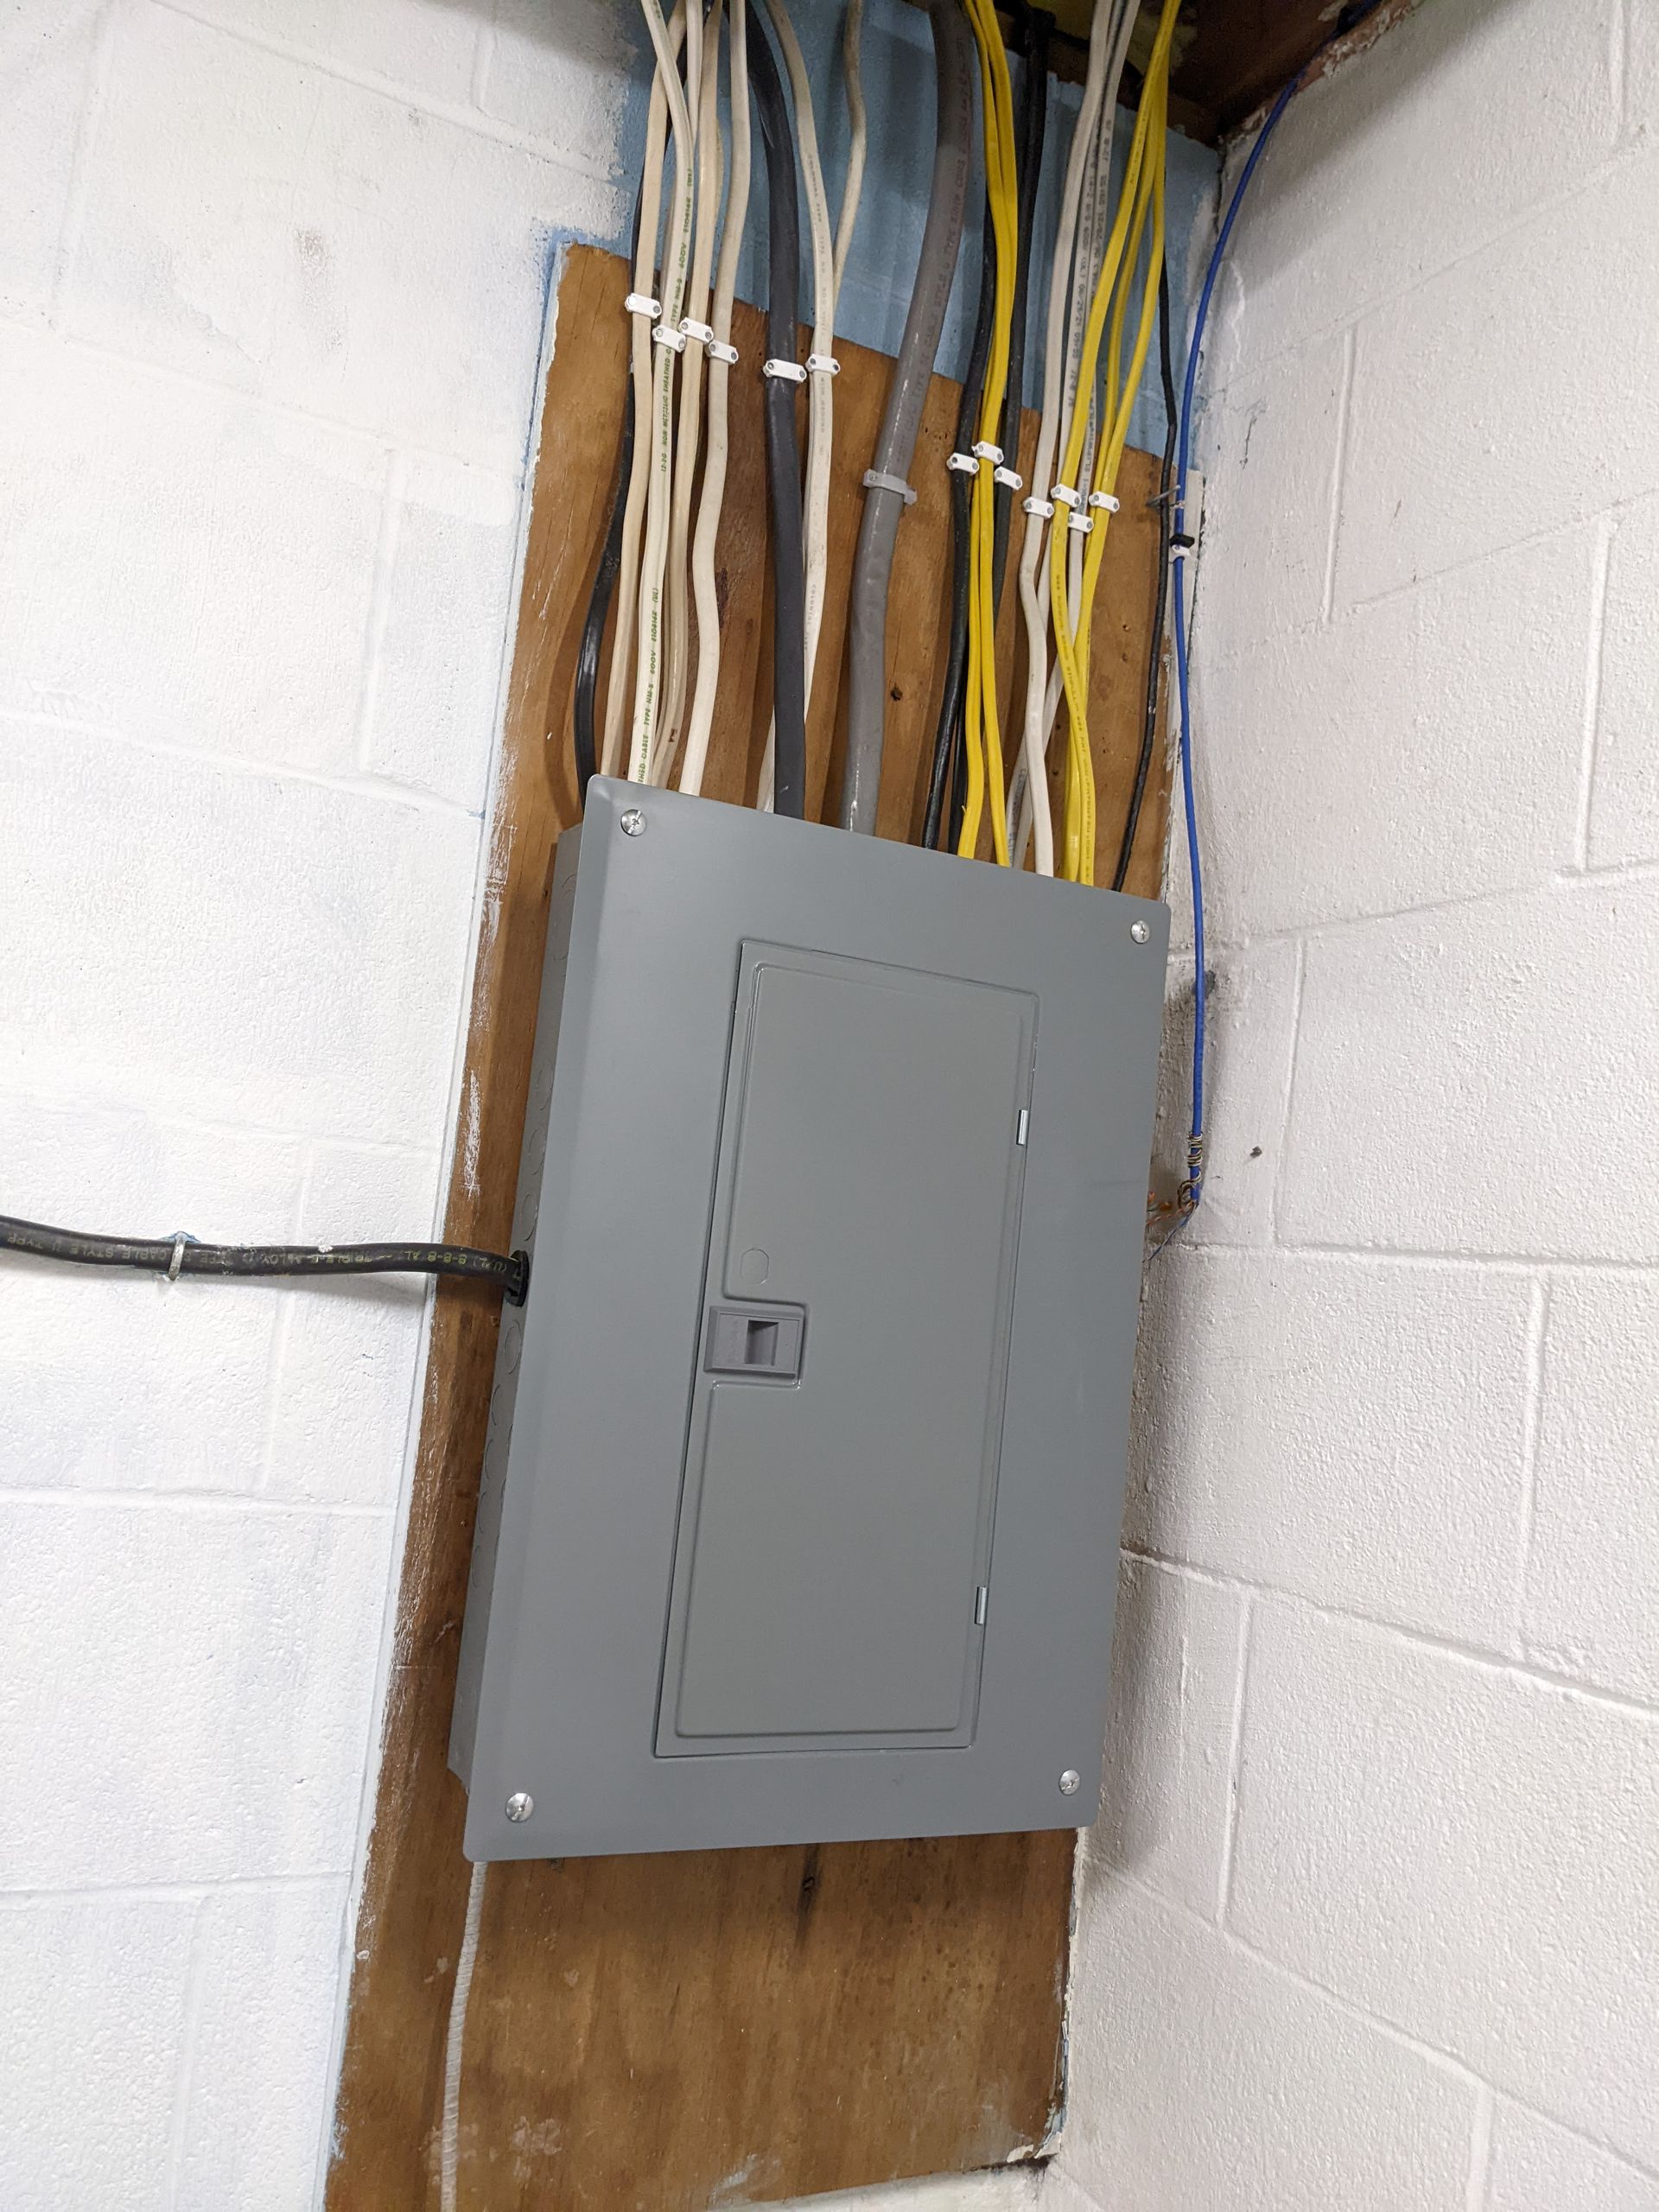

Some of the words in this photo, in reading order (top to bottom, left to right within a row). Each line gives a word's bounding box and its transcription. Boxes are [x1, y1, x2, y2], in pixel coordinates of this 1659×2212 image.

[678, 242, 687, 269] 600V
[69, 1247, 114, 1259] STYLE
[122, 1248, 168, 1262] CABLE
[427, 1251, 467, 1265] 8-8-8
